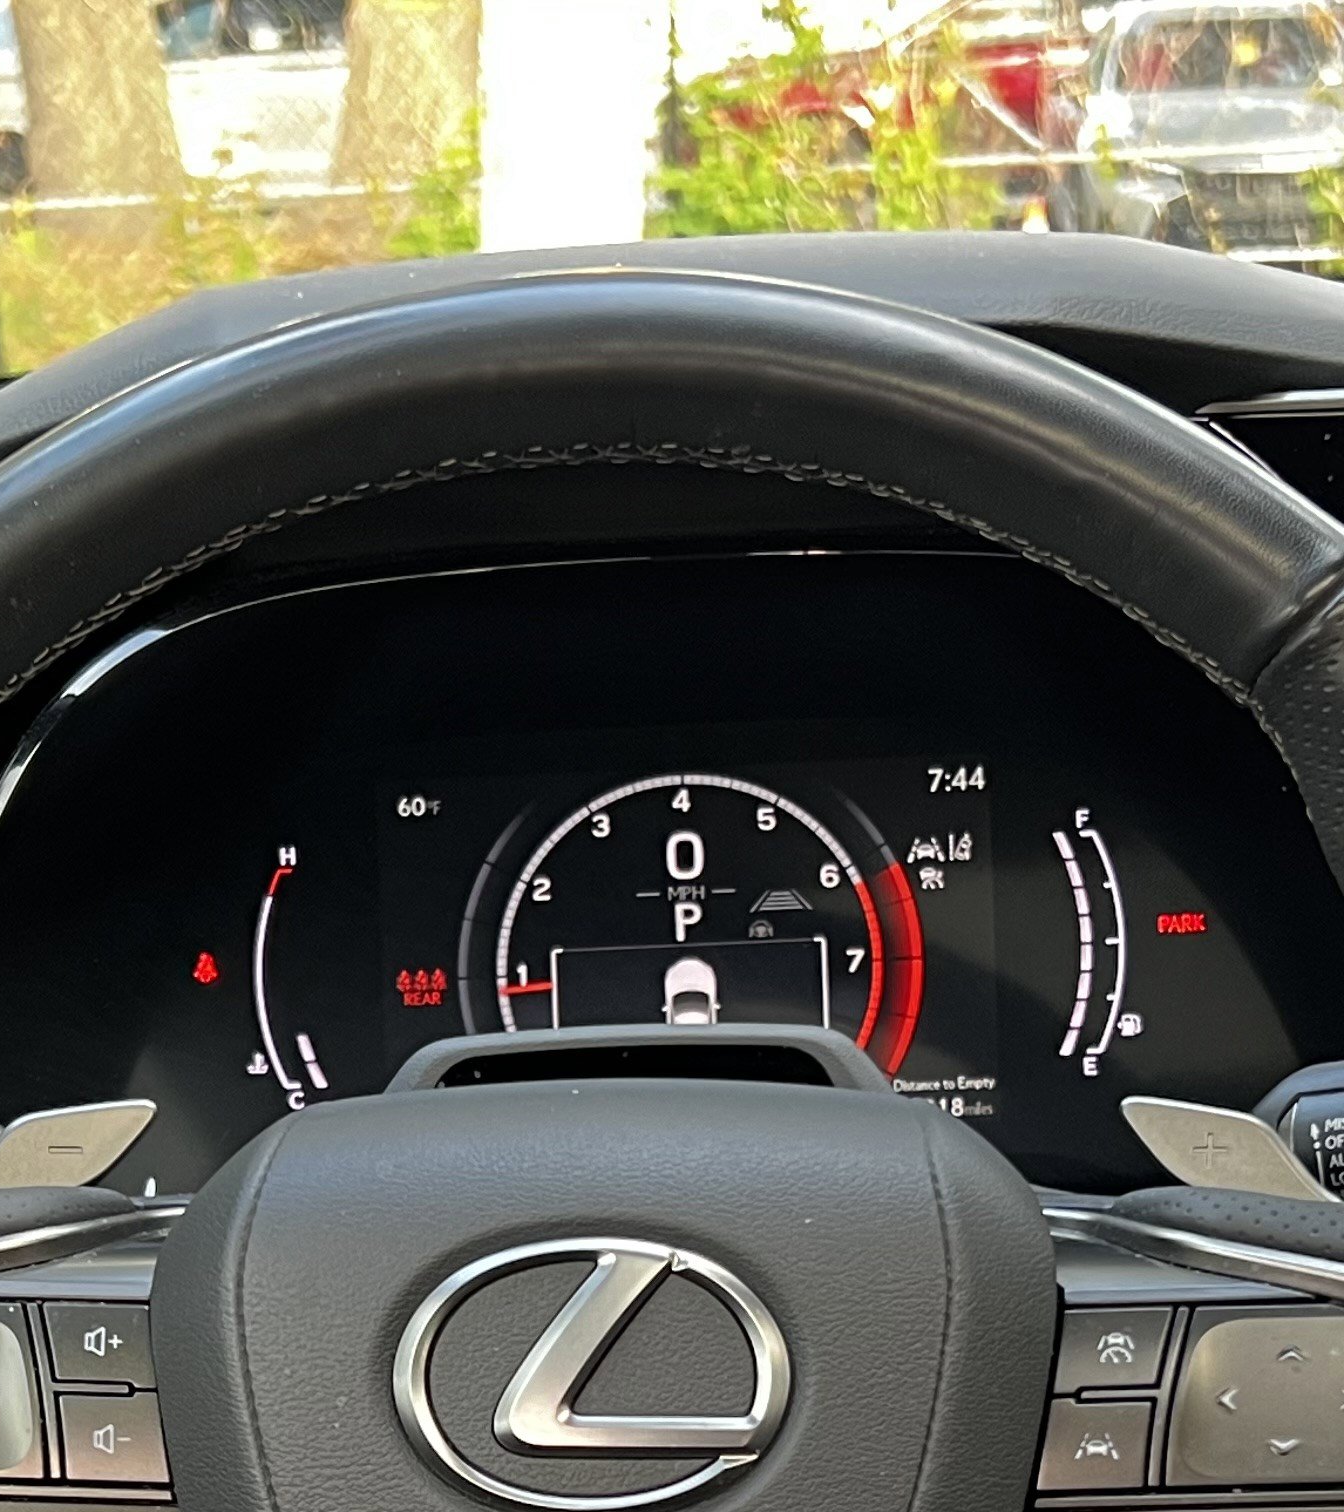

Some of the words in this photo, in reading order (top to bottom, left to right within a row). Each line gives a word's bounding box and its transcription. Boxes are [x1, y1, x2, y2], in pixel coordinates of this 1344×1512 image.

[927, 767, 986, 793] 7:44
[671, 788, 692, 813] 4
[590, 813, 611, 838] 3
[756, 807, 777, 831] 5
[1075, 808, 1091, 828] F
[278, 846, 297, 866] H
[665, 831, 705, 881] 0
[819, 864, 840, 889] 6
[531, 876, 552, 902] 2
[667, 886, 706, 900] MPH
[674, 902, 703, 942] P
[1158, 913, 1208, 934] PARK
[845, 948, 866, 973] 7
[516, 963, 529, 987] 1
[403, 993, 442, 1007] REAR
[1082, 1056, 1098, 1076] E
[894, 1079, 940, 1092] Distance
[943, 1079, 955, 1090] to
[957, 1076, 995, 1091] Empty
[287, 1091, 306, 1111] C
